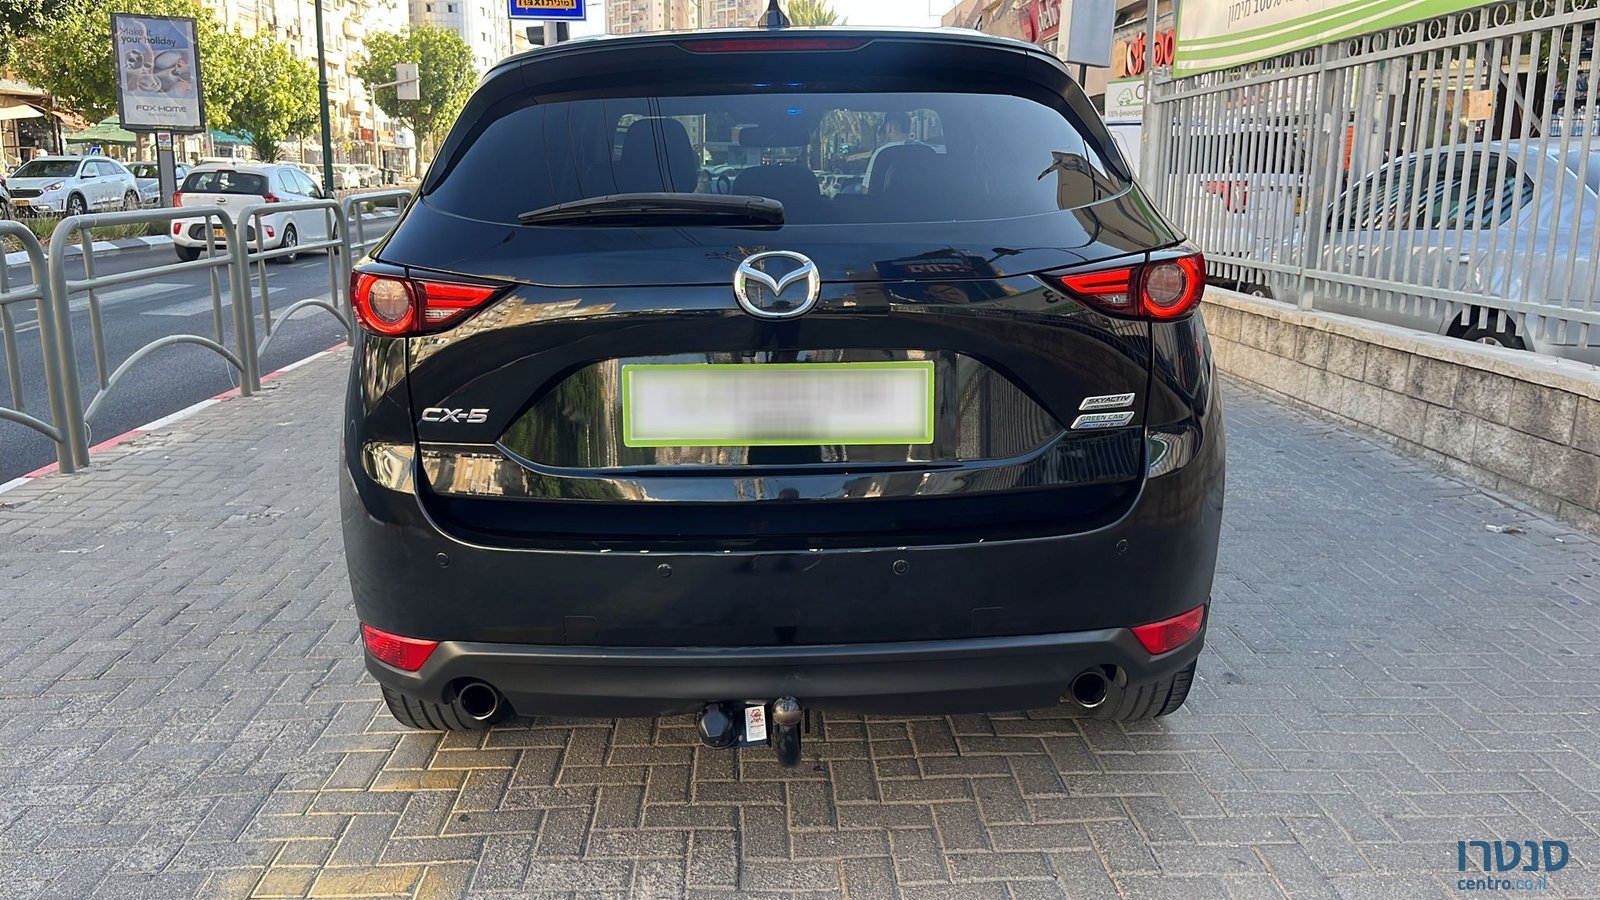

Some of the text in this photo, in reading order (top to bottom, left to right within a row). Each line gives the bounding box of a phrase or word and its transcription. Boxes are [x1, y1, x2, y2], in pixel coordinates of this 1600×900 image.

[1227, 0, 1251, 29] מימון
[120, 27, 143, 36] Make
[121, 36, 176, 47] your holiday
[1087, 395, 1132, 404] SKYACTIV
[421, 407, 490, 423] CX-5
[1080, 414, 1106, 422] GREEN
